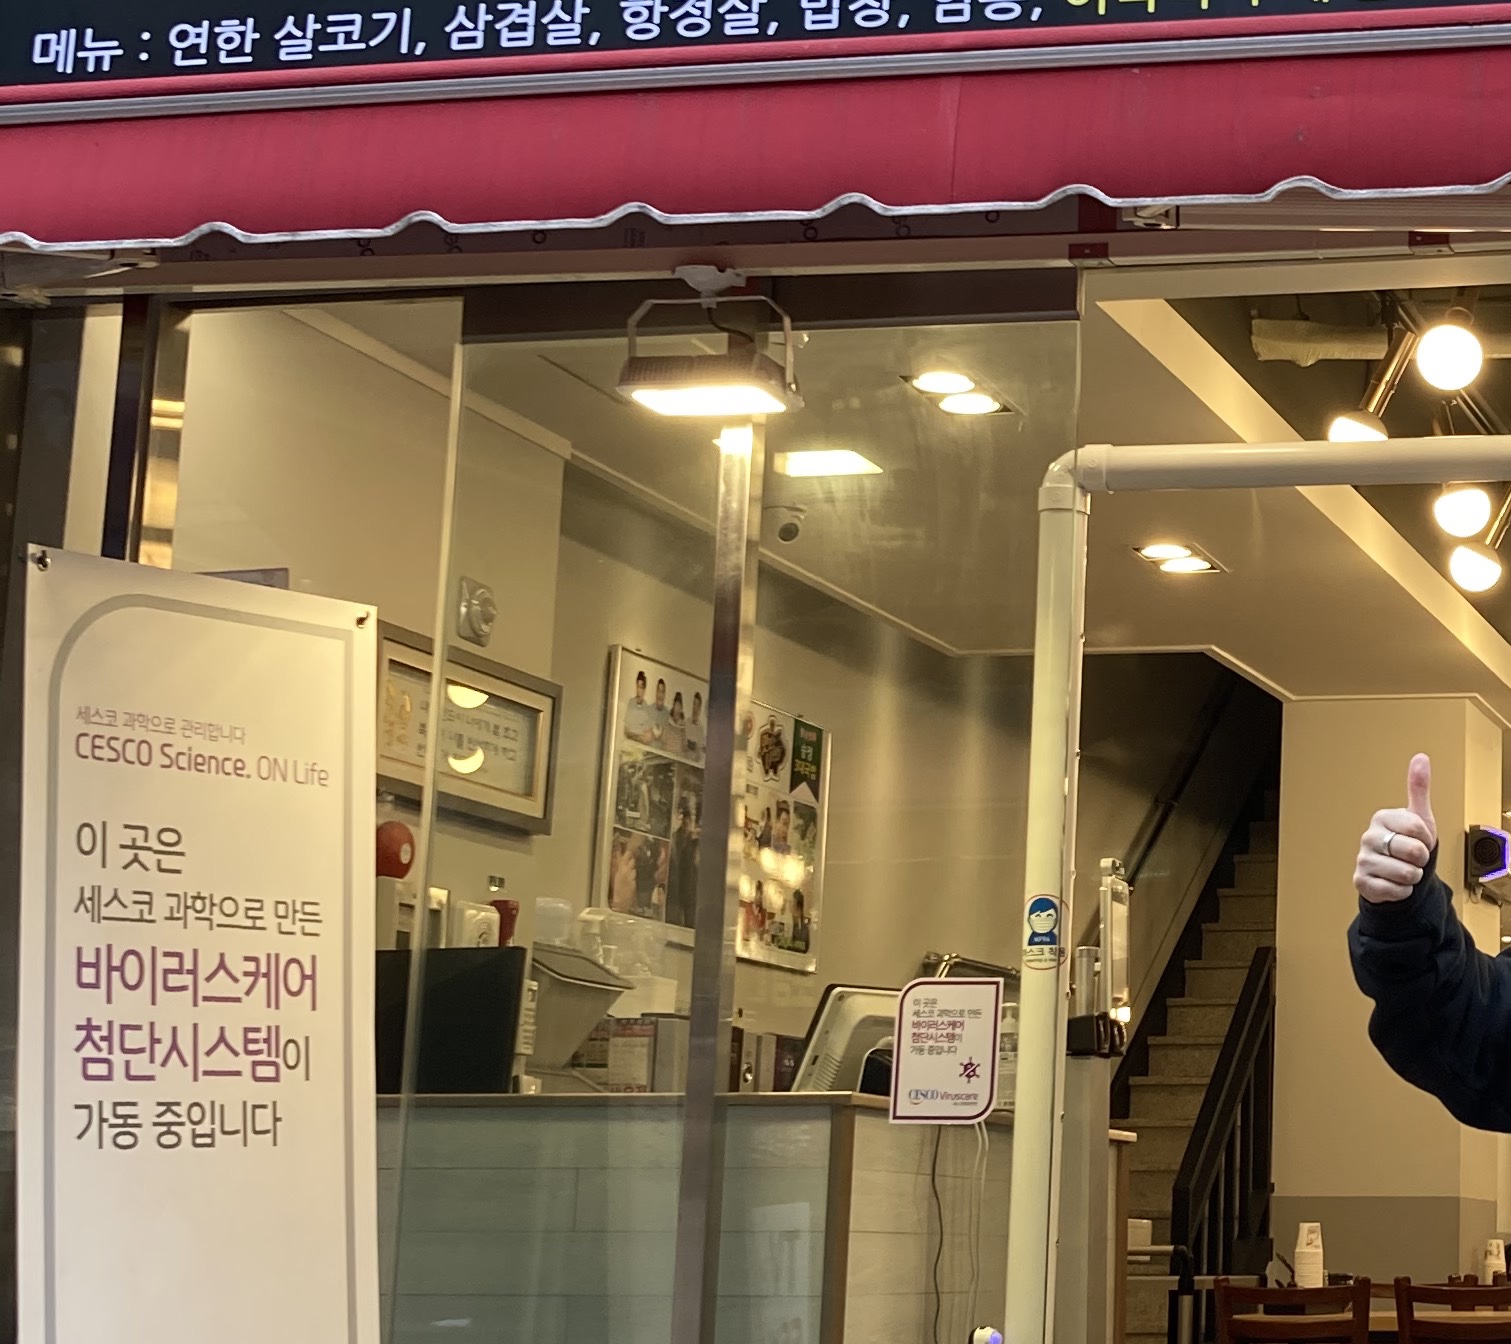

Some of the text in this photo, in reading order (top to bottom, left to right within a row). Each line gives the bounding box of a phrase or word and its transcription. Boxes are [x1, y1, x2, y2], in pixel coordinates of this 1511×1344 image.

[31, 28, 124, 74] 메뉴
[167, 17, 261, 67] 연한
[273, 7, 427, 62] 살코기,
[74, 731, 330, 788] CESCO Science. ON Life
[76, 820, 187, 875] 이 곳은
[74, 885, 323, 939] 세스코 과학으로 만든
[76, 944, 319, 1012] 바이러스케어
[73, 1017, 312, 1084] 첨단시스템이
[73, 1099, 282, 1152] 가동 중입니다
